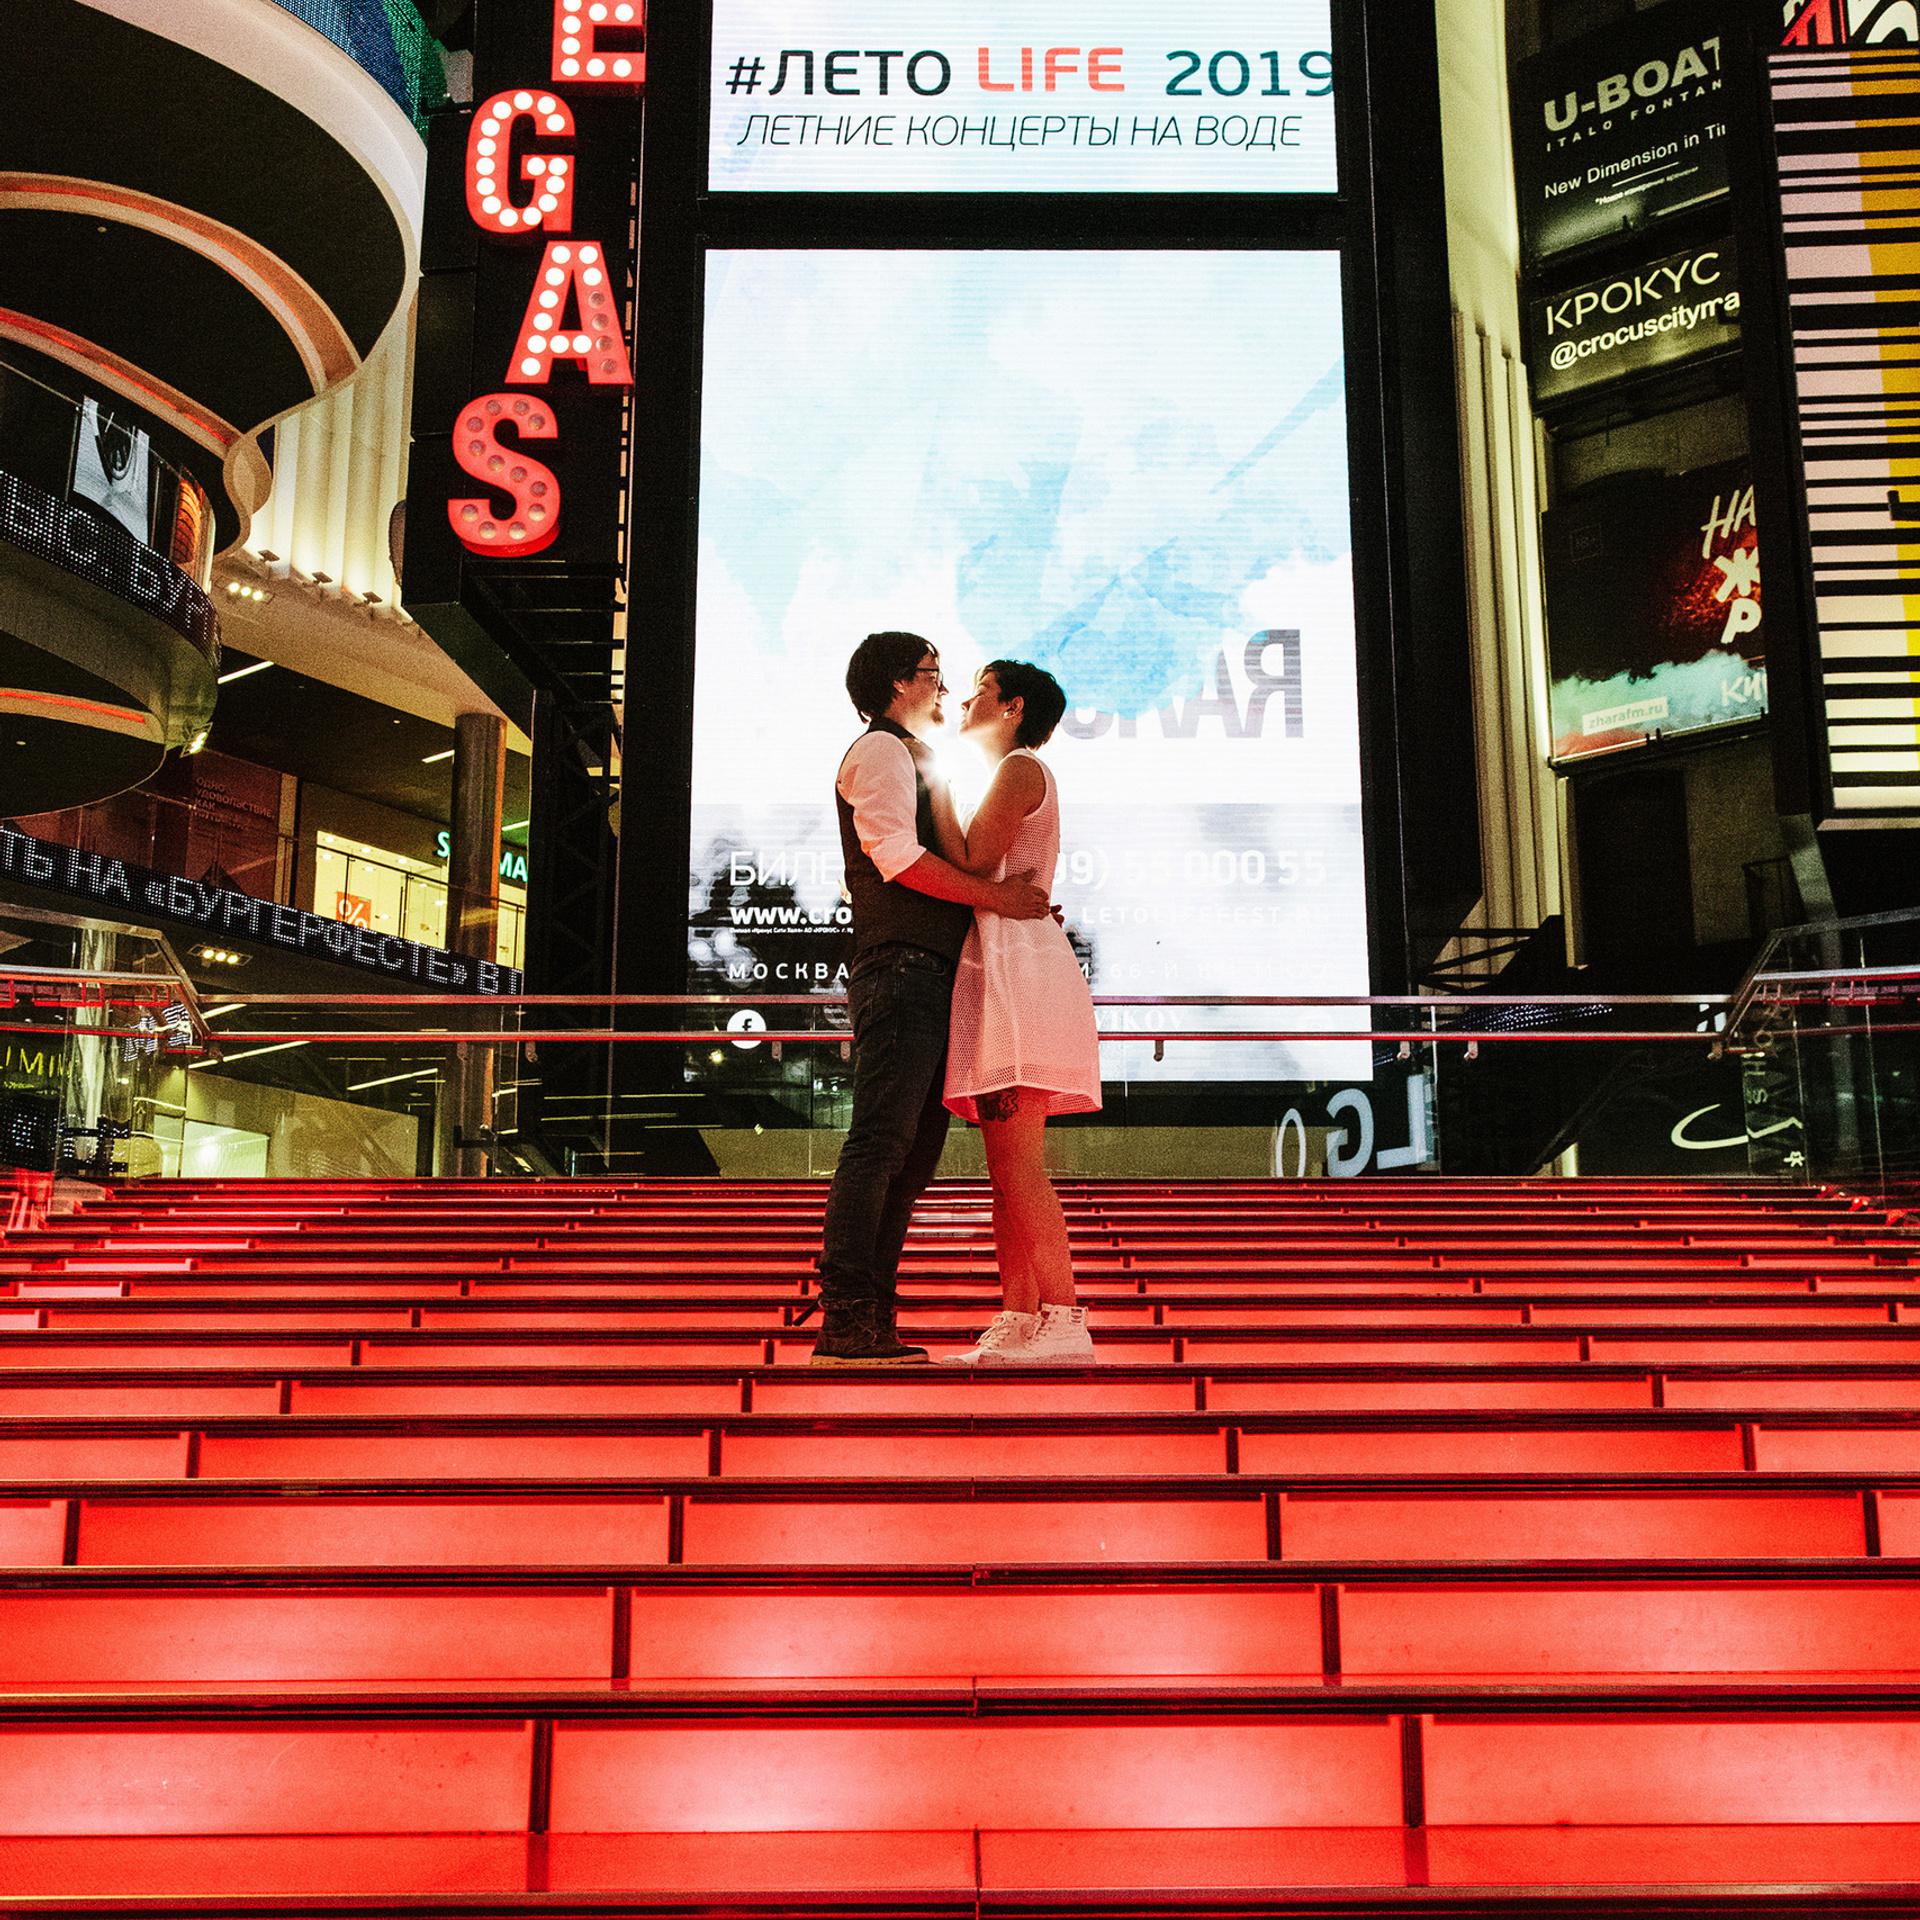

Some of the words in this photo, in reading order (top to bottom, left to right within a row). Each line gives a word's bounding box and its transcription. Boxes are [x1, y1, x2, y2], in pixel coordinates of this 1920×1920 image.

[725, 50, 951, 97] #ЛЕТО
[977, 47, 1126, 92] LIFE
[1165, 50, 1332, 97] 2019
[738, 115, 895, 146] ЛЕТНИЕ
[906, 115, 1118, 151] КОНЦЕРТЫ
[1131, 116, 1182, 146] НА
[1195, 115, 1302, 151] ВОДЕ
[1546, 120, 1613, 152] ITALO
[1630, 79, 1722, 121] FONTAN
[1544, 176, 1582, 199] New
[1587, 141, 1679, 184] Dimension
[1684, 134, 1700, 148] in
[1546, 252, 1721, 336] КРОКУС
[1721, 672, 1769, 707] КИ
[1589, 704, 1663, 729] zharafm.ru
[67, 848, 131, 902] НА
[729, 906, 853, 926] www.cro
[729, 962, 850, 979] МОСКВА
